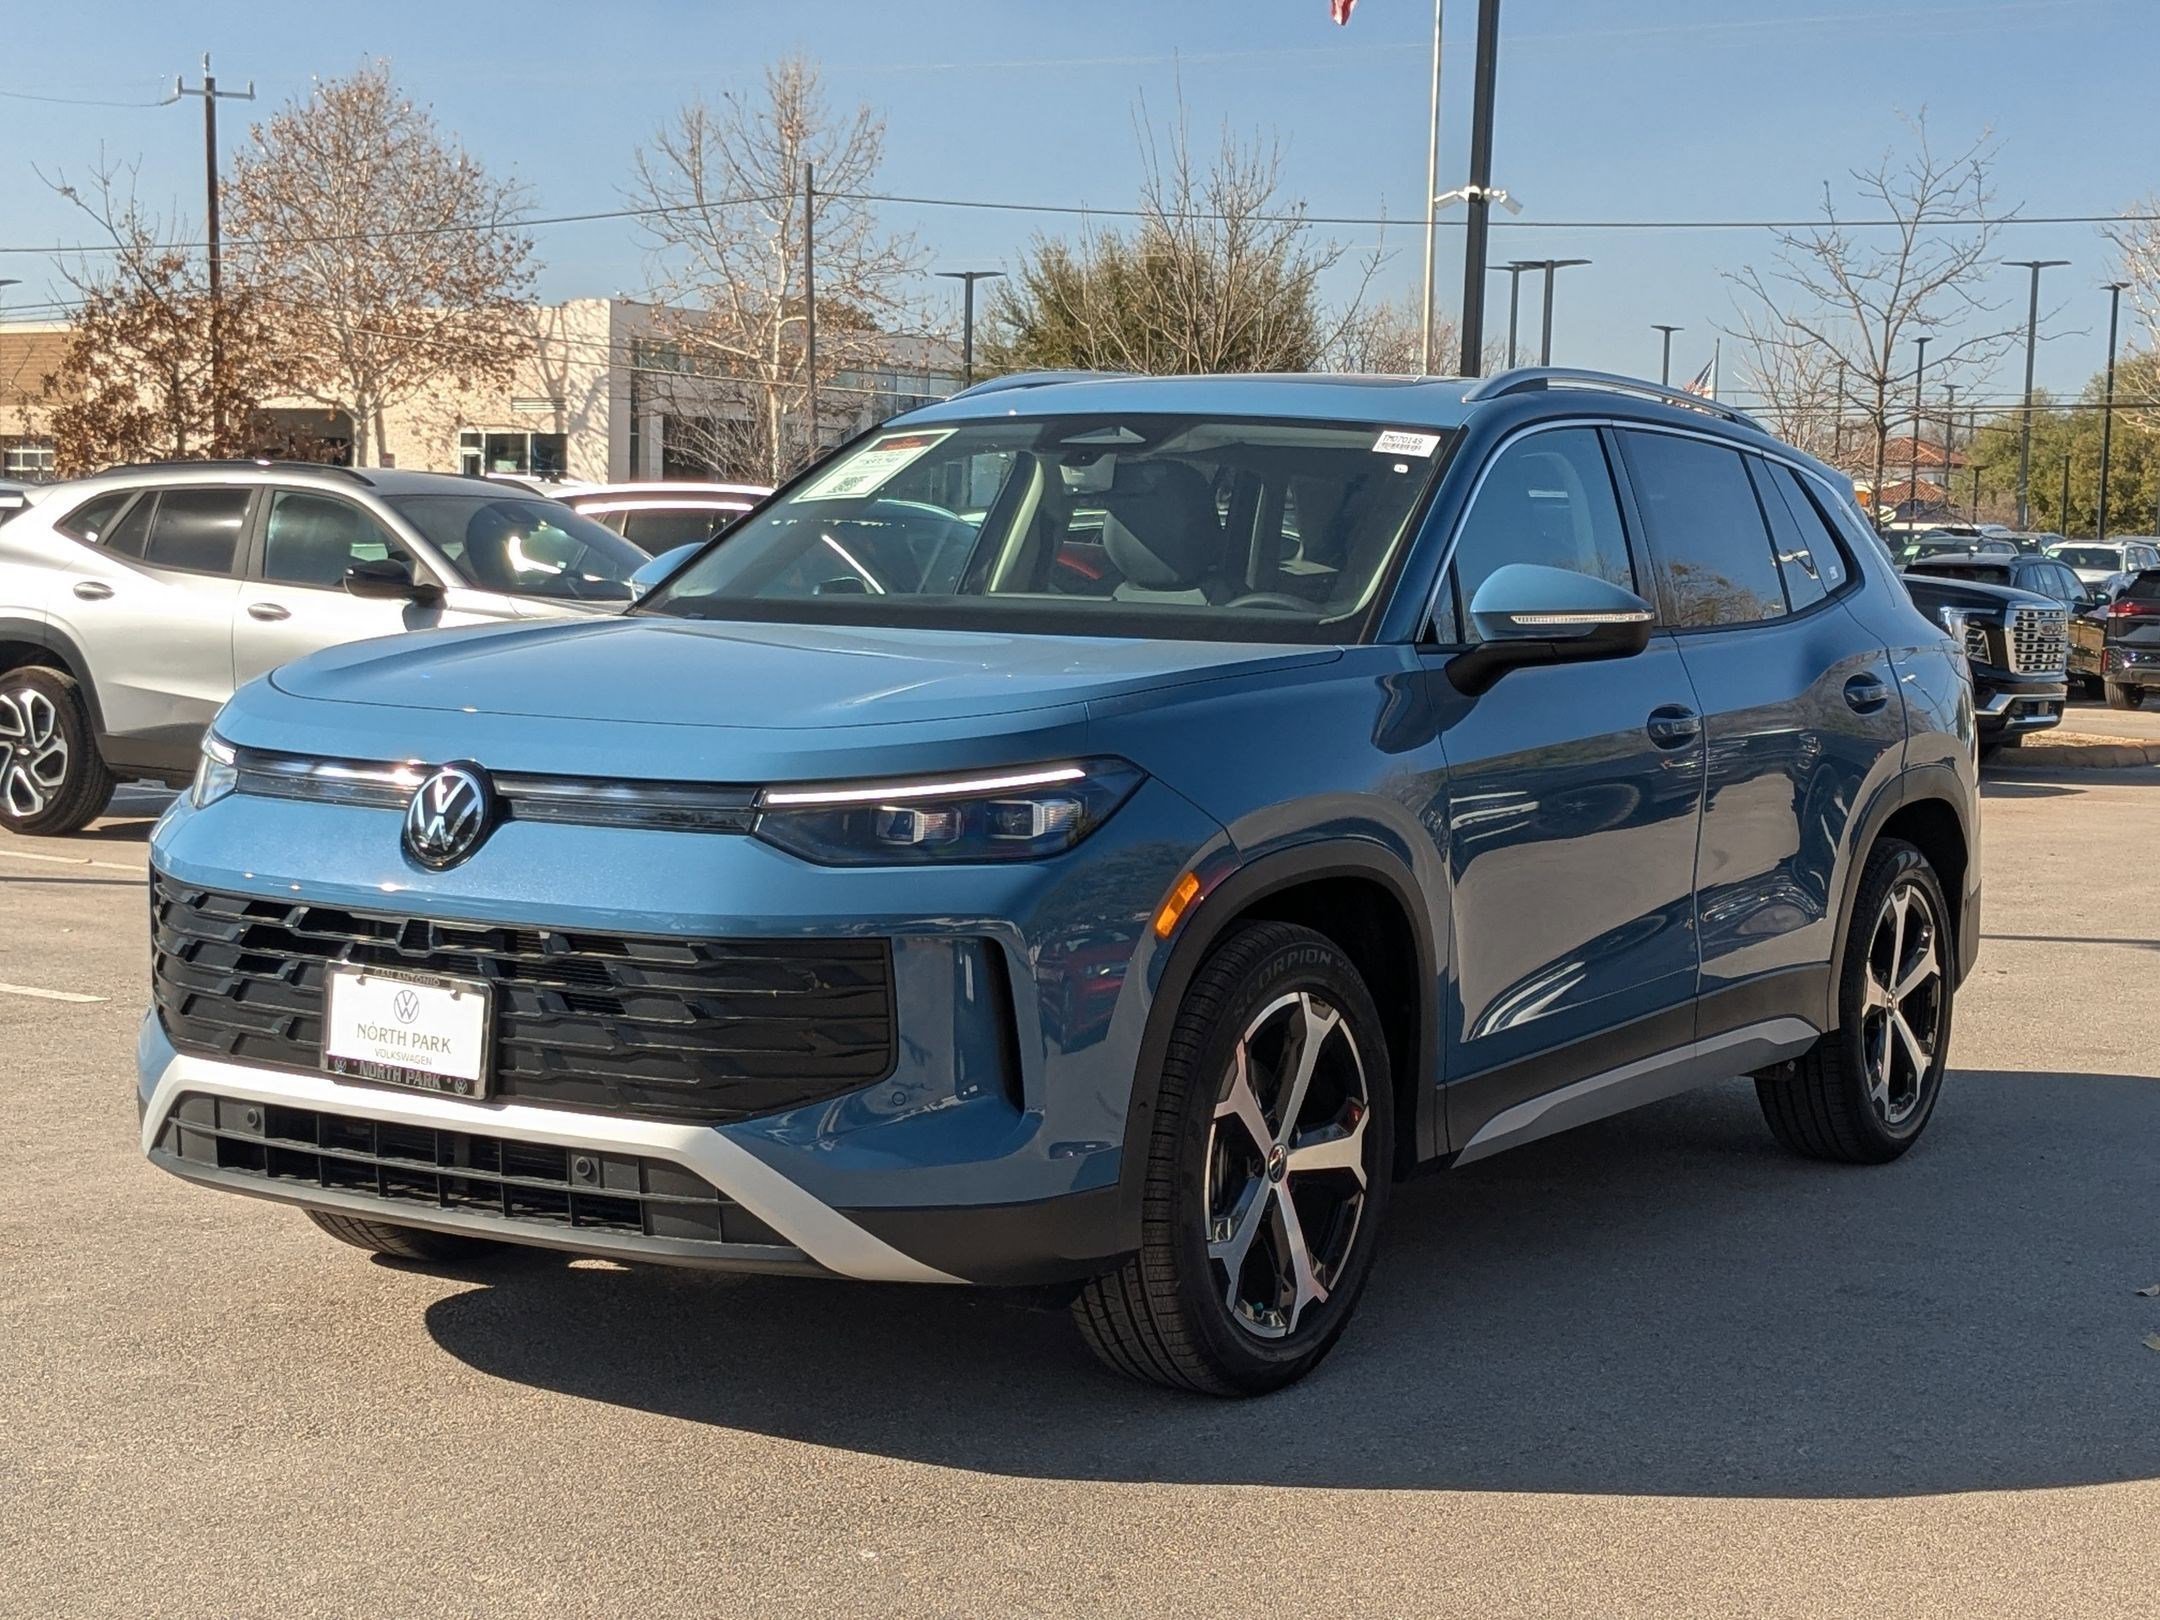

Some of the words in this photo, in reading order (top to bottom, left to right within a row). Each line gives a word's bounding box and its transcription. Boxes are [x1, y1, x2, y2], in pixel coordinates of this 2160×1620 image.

[357, 1022, 407, 1046] NORTH
[412, 1034, 452, 1054] PARK
[375, 1048, 433, 1065] VOLKSWAGEN
[359, 1061, 402, 1082] NORTH
[405, 1069, 442, 1089] PARK
